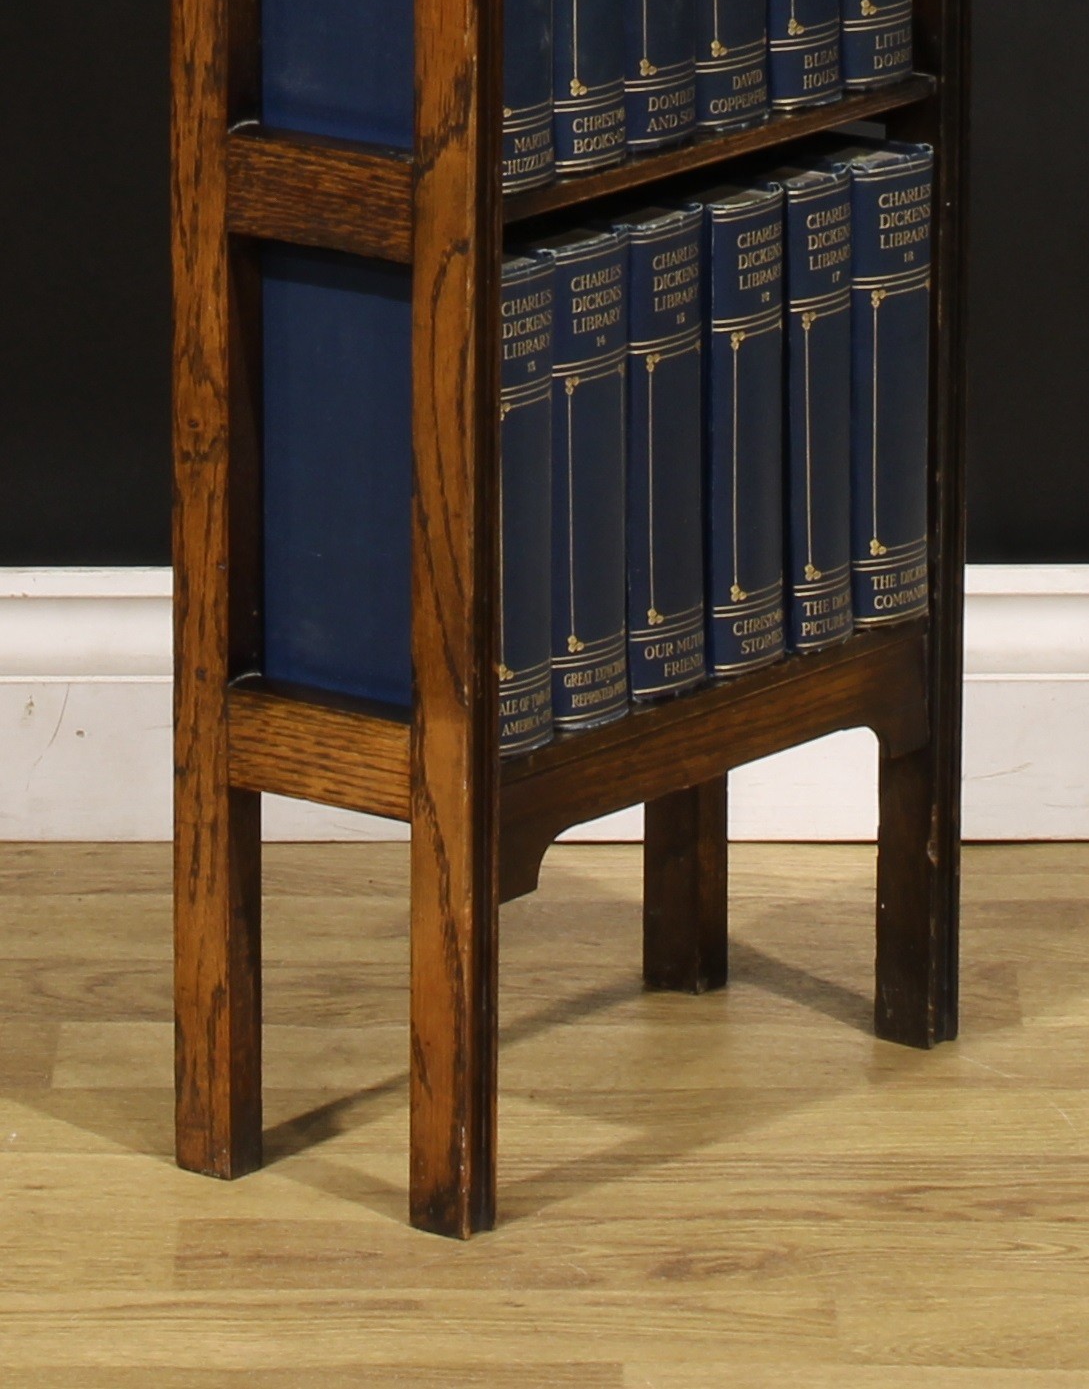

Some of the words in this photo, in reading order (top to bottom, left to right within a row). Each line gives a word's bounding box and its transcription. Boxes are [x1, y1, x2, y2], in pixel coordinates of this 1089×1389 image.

[732, 69, 763, 90] DAVID
[647, 114, 678, 133] AND
[878, 183, 931, 208] CHARLES
[653, 243, 699, 270] CHARLES
[570, 264, 622, 292] CHARLES
[653, 263, 699, 292] DICKENS
[832, 270, 840, 283] 17
[501, 289, 552, 317] CHARLES
[572, 285, 622, 313] DICKENS
[654, 283, 699, 312] LIBRARY
[502, 309, 552, 339] DICKENS
[573, 306, 621, 334] LIBRARY
[596, 335, 606, 347] 14
[871, 574, 897, 590] THE
[803, 599, 830, 616] THE
[644, 644, 674, 661] OUR
[564, 671, 593, 688] GREAT
[500, 699, 517, 716] ALE
